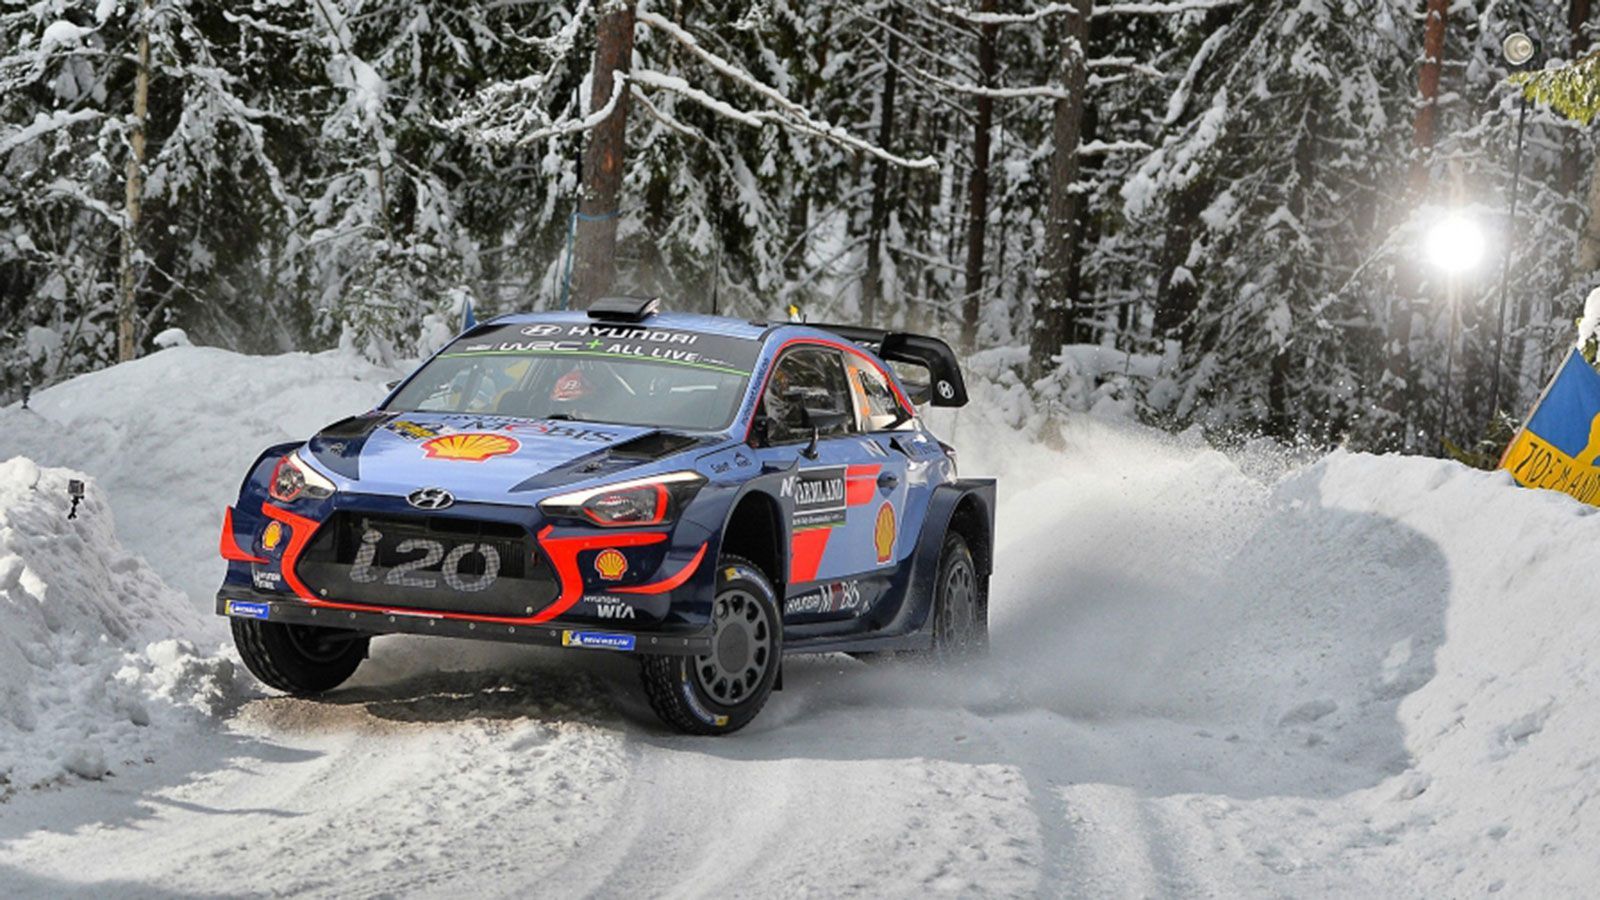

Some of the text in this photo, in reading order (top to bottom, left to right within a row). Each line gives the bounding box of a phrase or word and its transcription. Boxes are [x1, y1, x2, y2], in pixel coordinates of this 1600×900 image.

[567, 325, 700, 344] HYUNDAI
[606, 343, 645, 356] ALL
[650, 347, 701, 361] LIVE
[350, 528, 501, 592] i20
[583, 635, 630, 647] MICHELIN
